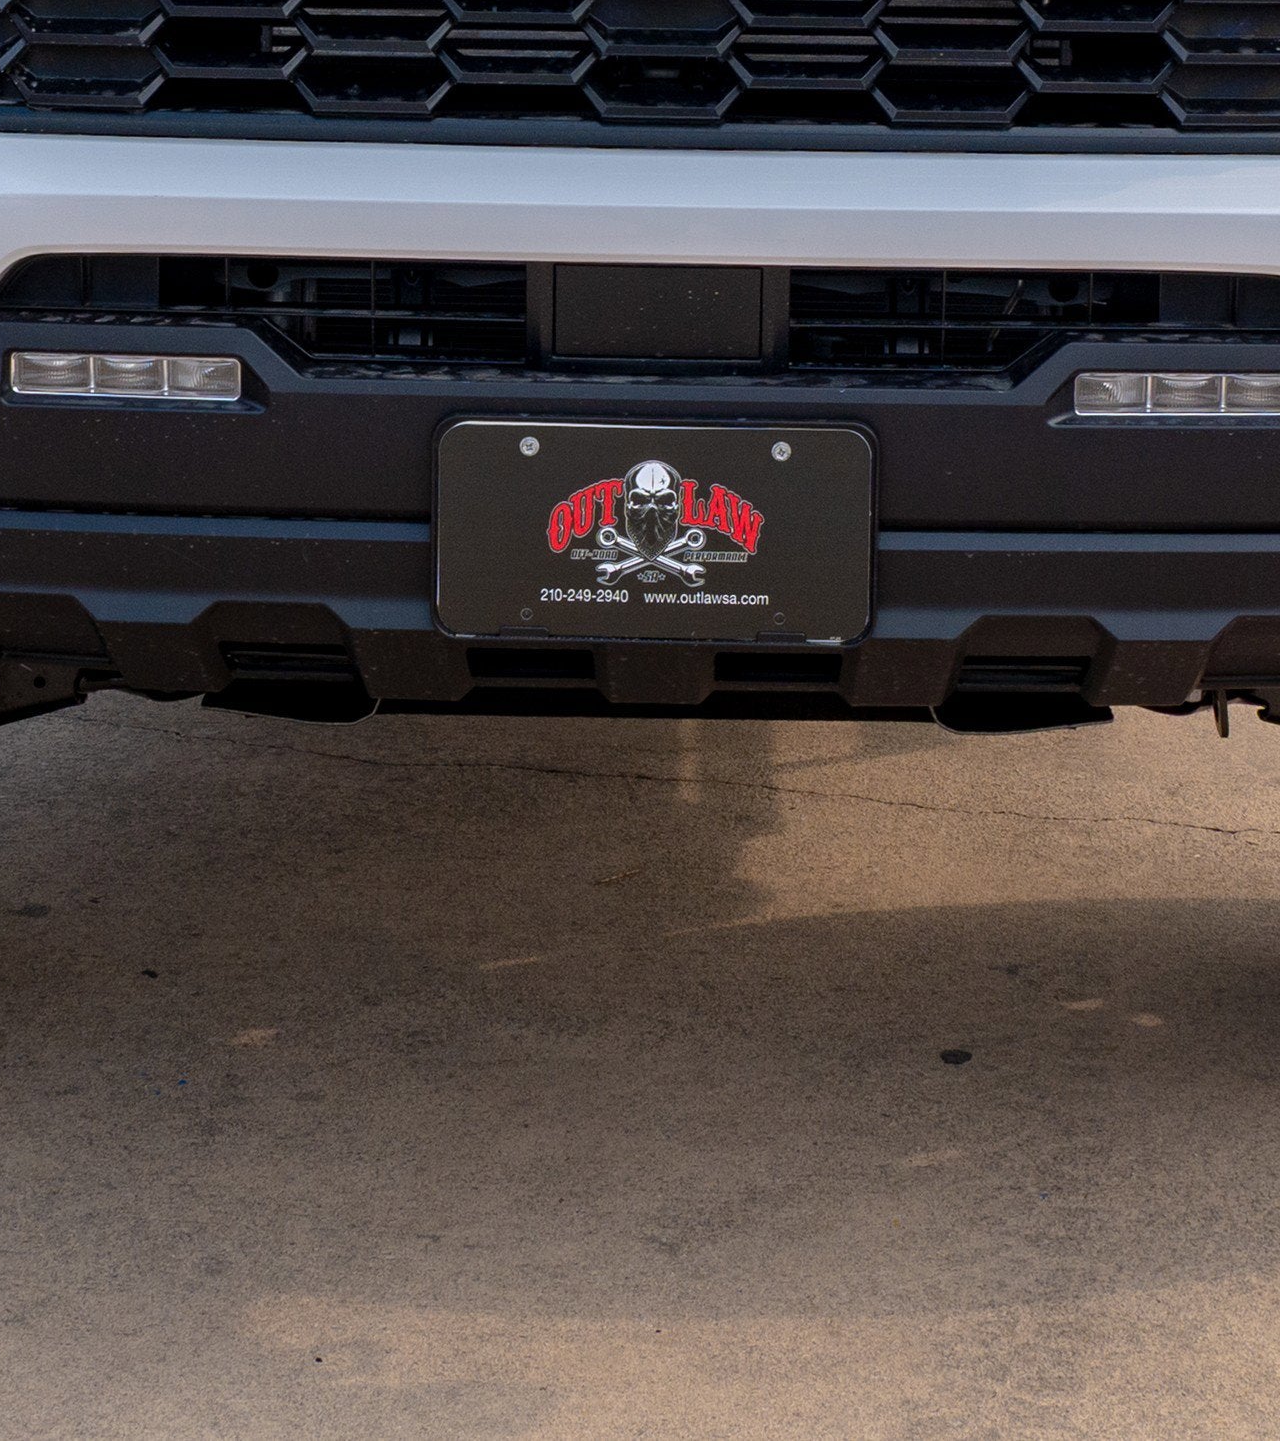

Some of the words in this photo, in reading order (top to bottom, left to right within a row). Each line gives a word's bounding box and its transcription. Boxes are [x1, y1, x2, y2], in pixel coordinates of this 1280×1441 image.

[547, 479, 624, 553] OUT
[680, 479, 764, 555] LAW
[540, 588, 629, 603] 210-249-2940
[643, 591, 769, 606] www.outlawsa.com
